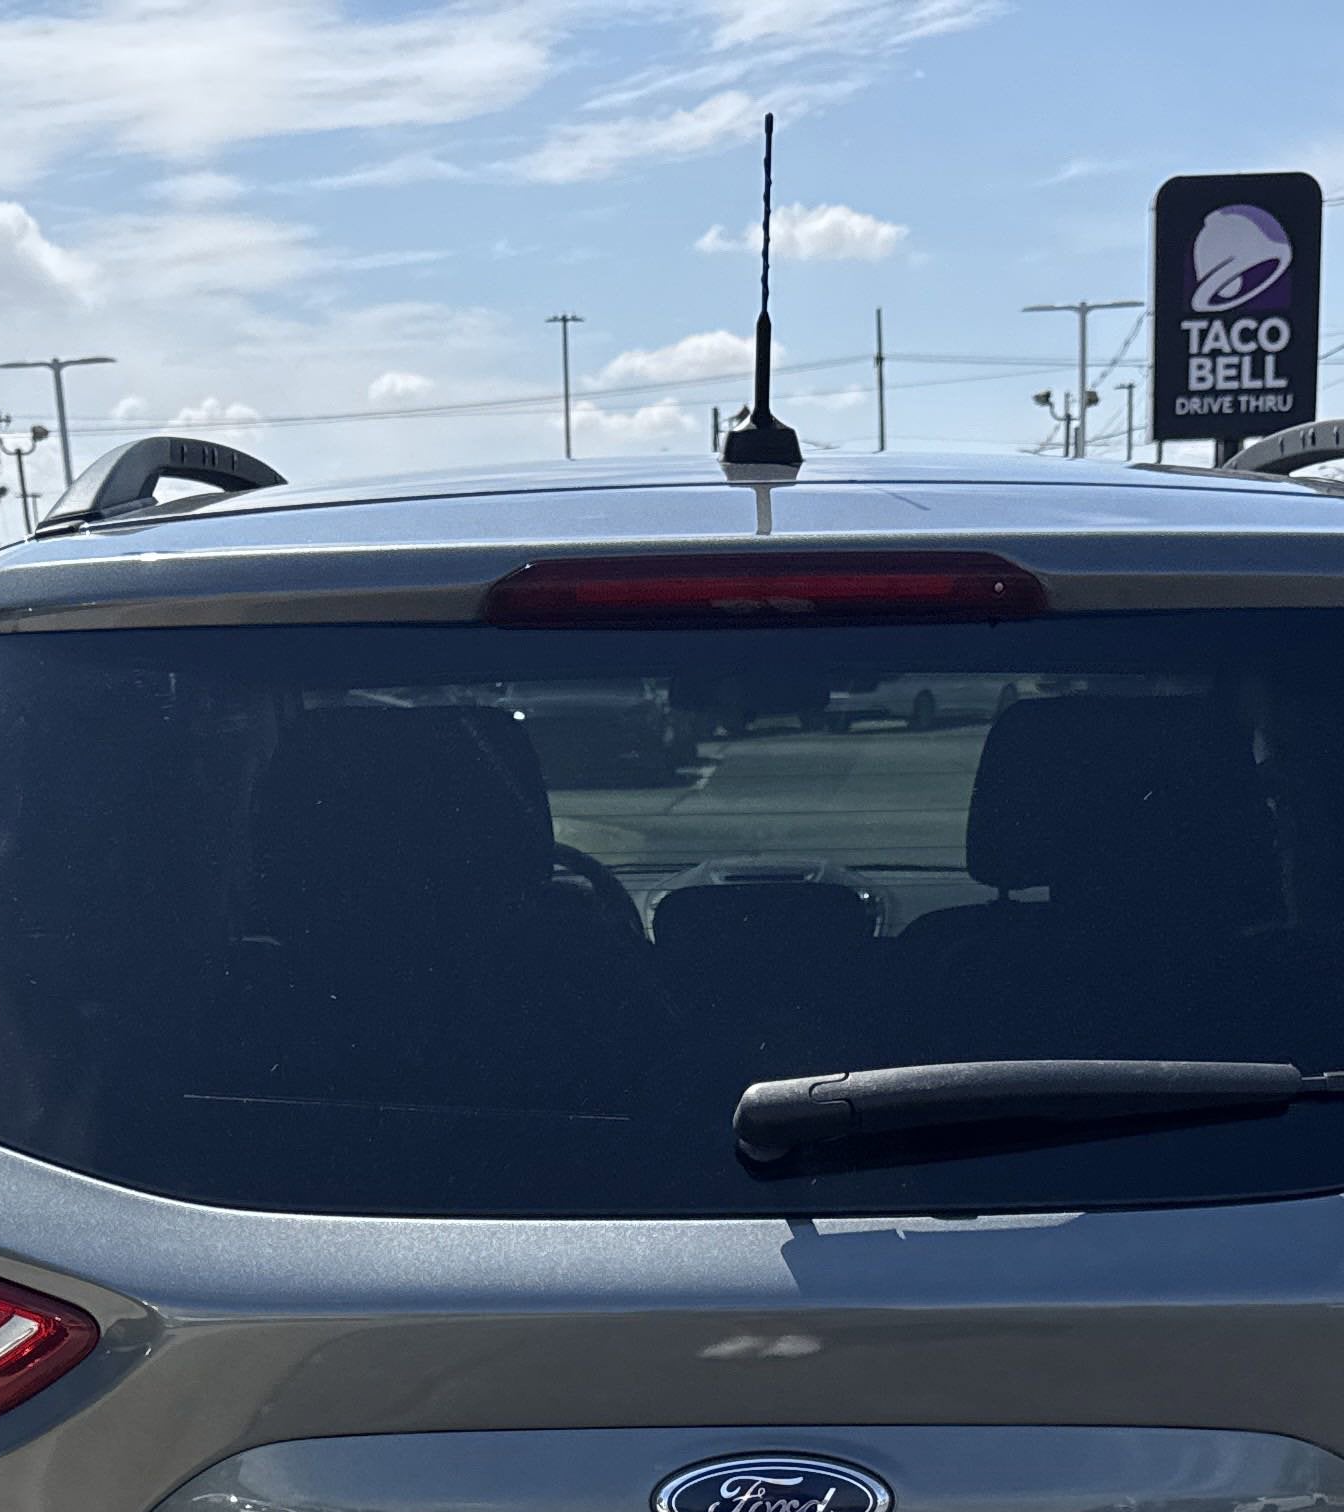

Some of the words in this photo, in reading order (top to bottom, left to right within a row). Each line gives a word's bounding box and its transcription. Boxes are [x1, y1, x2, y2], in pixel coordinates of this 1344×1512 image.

[1180, 317, 1292, 354] TACO
[1188, 354, 1289, 391] BELL
[1175, 396, 1234, 416] DRIVE
[1237, 394, 1295, 413] THRU
